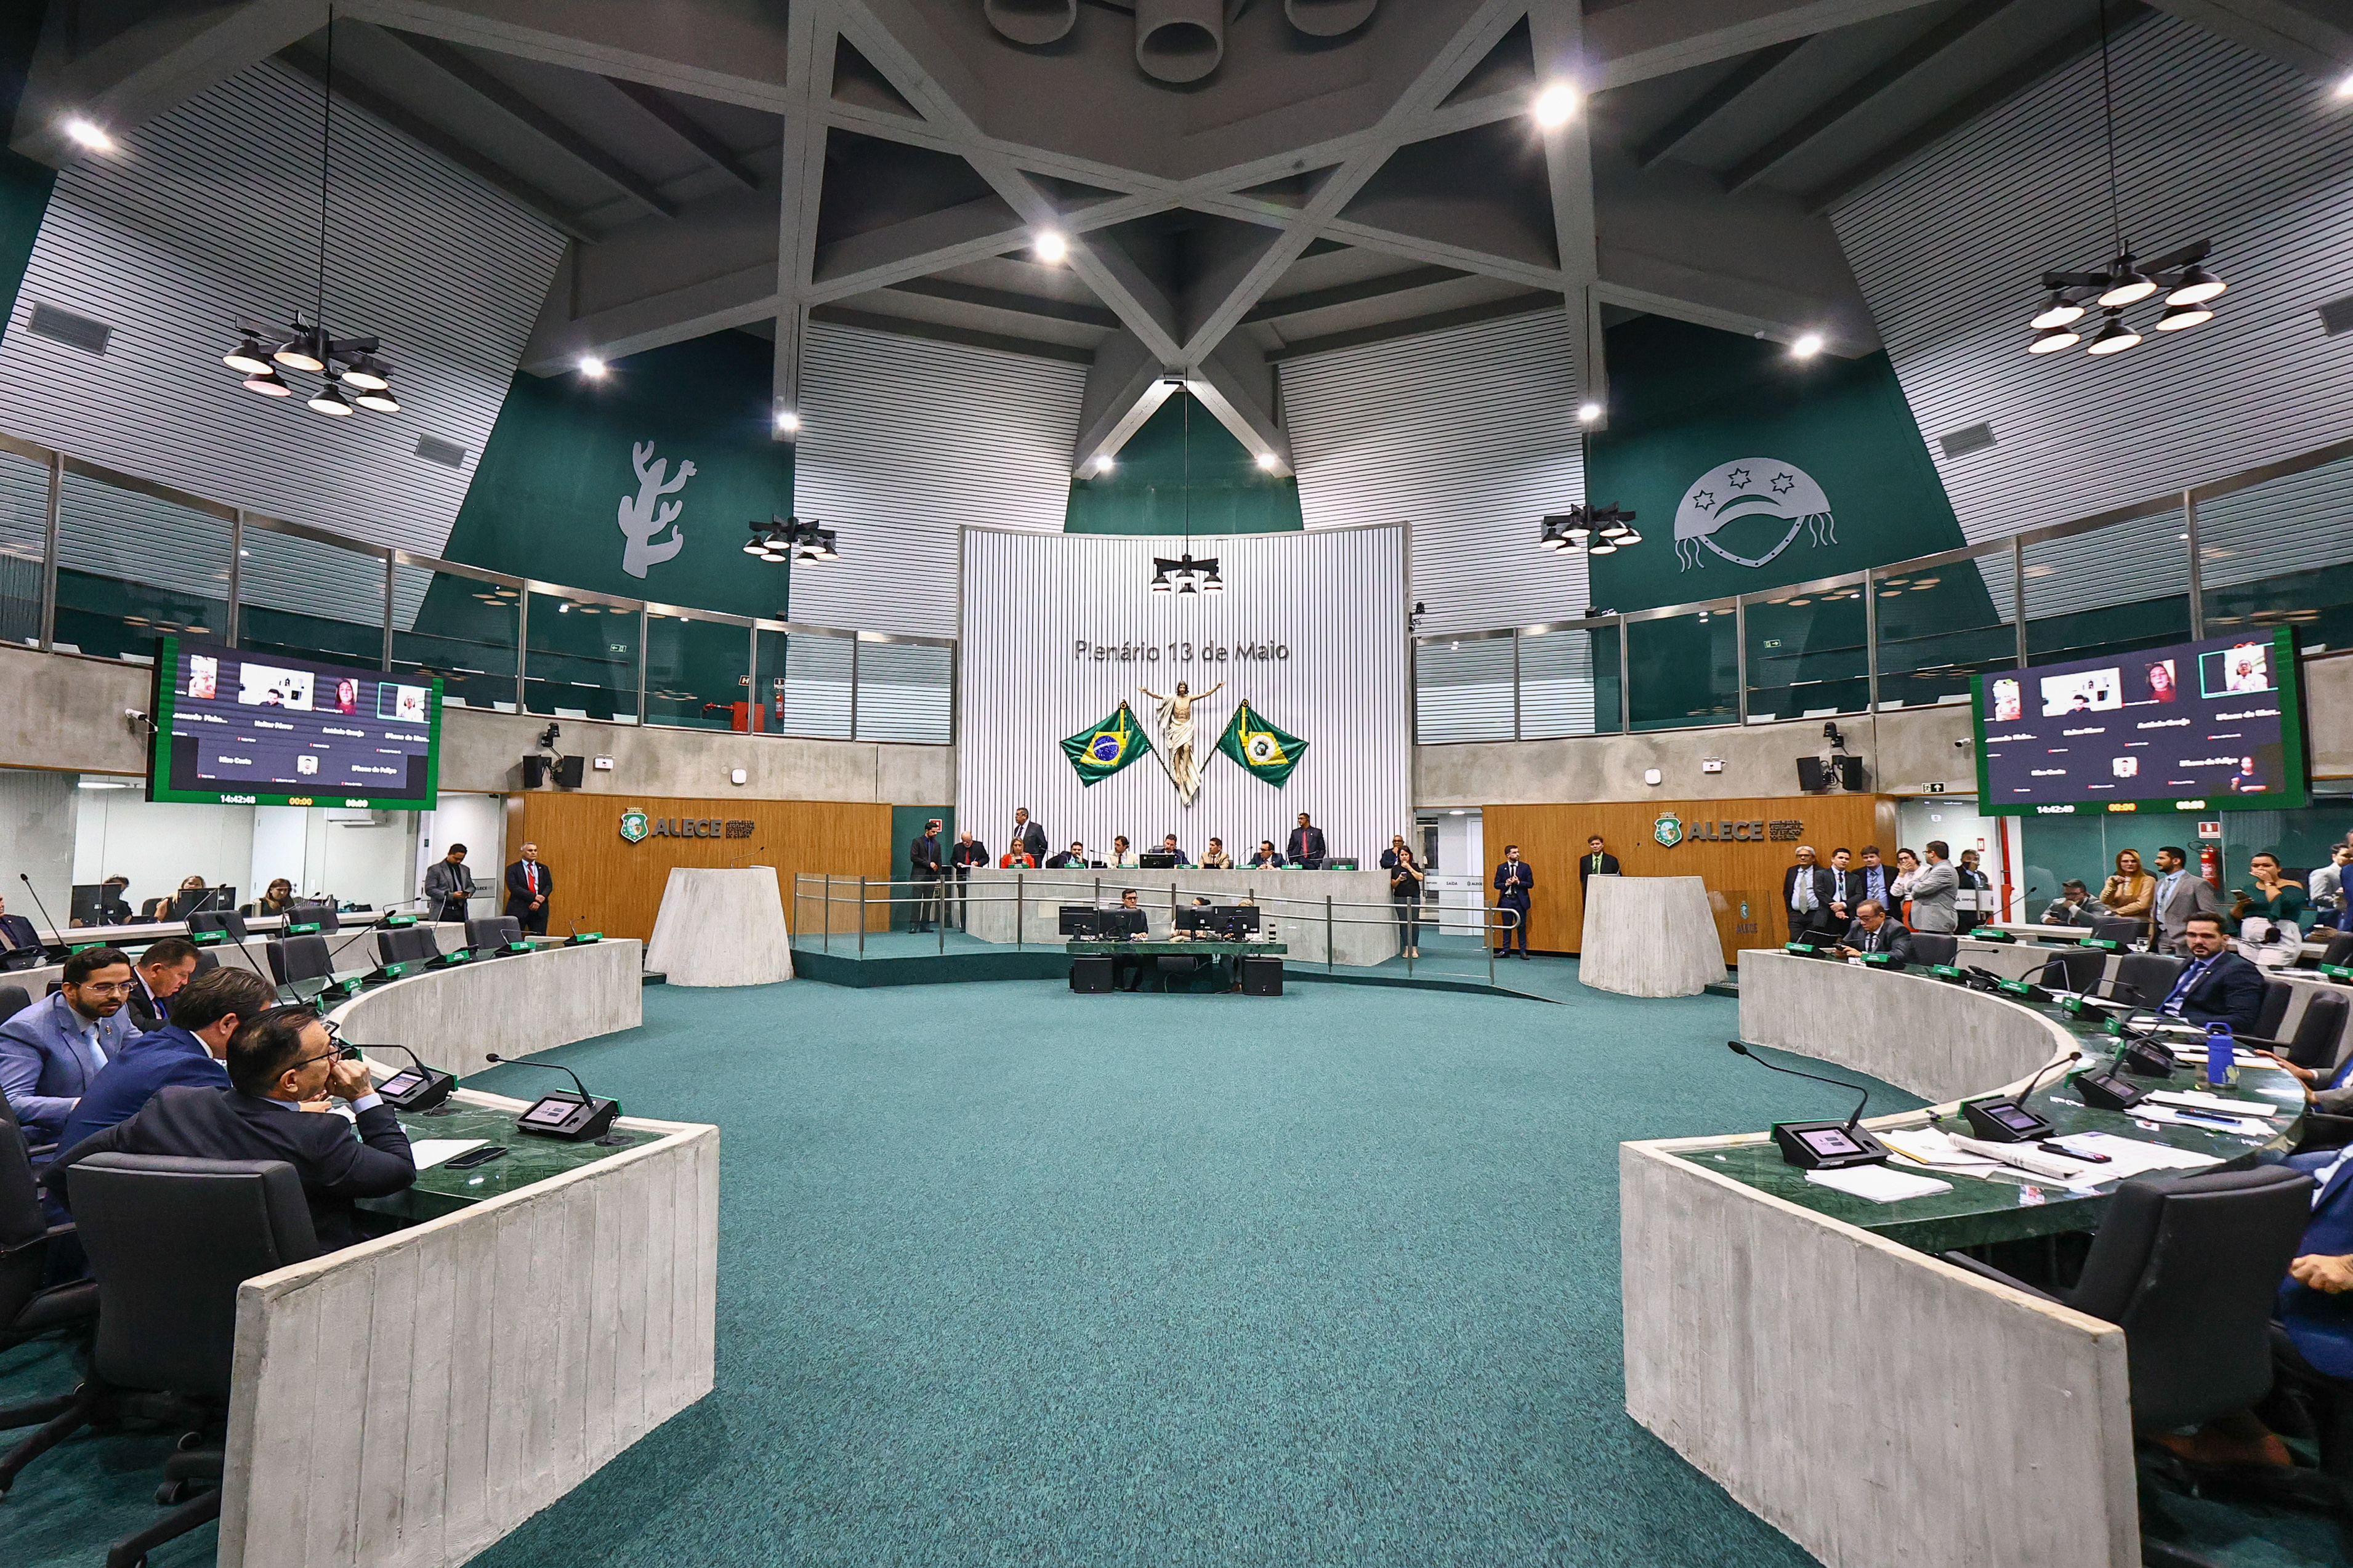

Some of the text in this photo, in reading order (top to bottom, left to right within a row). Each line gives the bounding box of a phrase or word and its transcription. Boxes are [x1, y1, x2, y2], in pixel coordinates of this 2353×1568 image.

[1075, 640, 1290, 662] Plenário 13 de Maio
[220, 794, 256, 804] 14:42:48
[289, 797, 313, 806] 00:00
[652, 818, 723, 837] ALECE
[1687, 821, 1764, 841] ALECE
